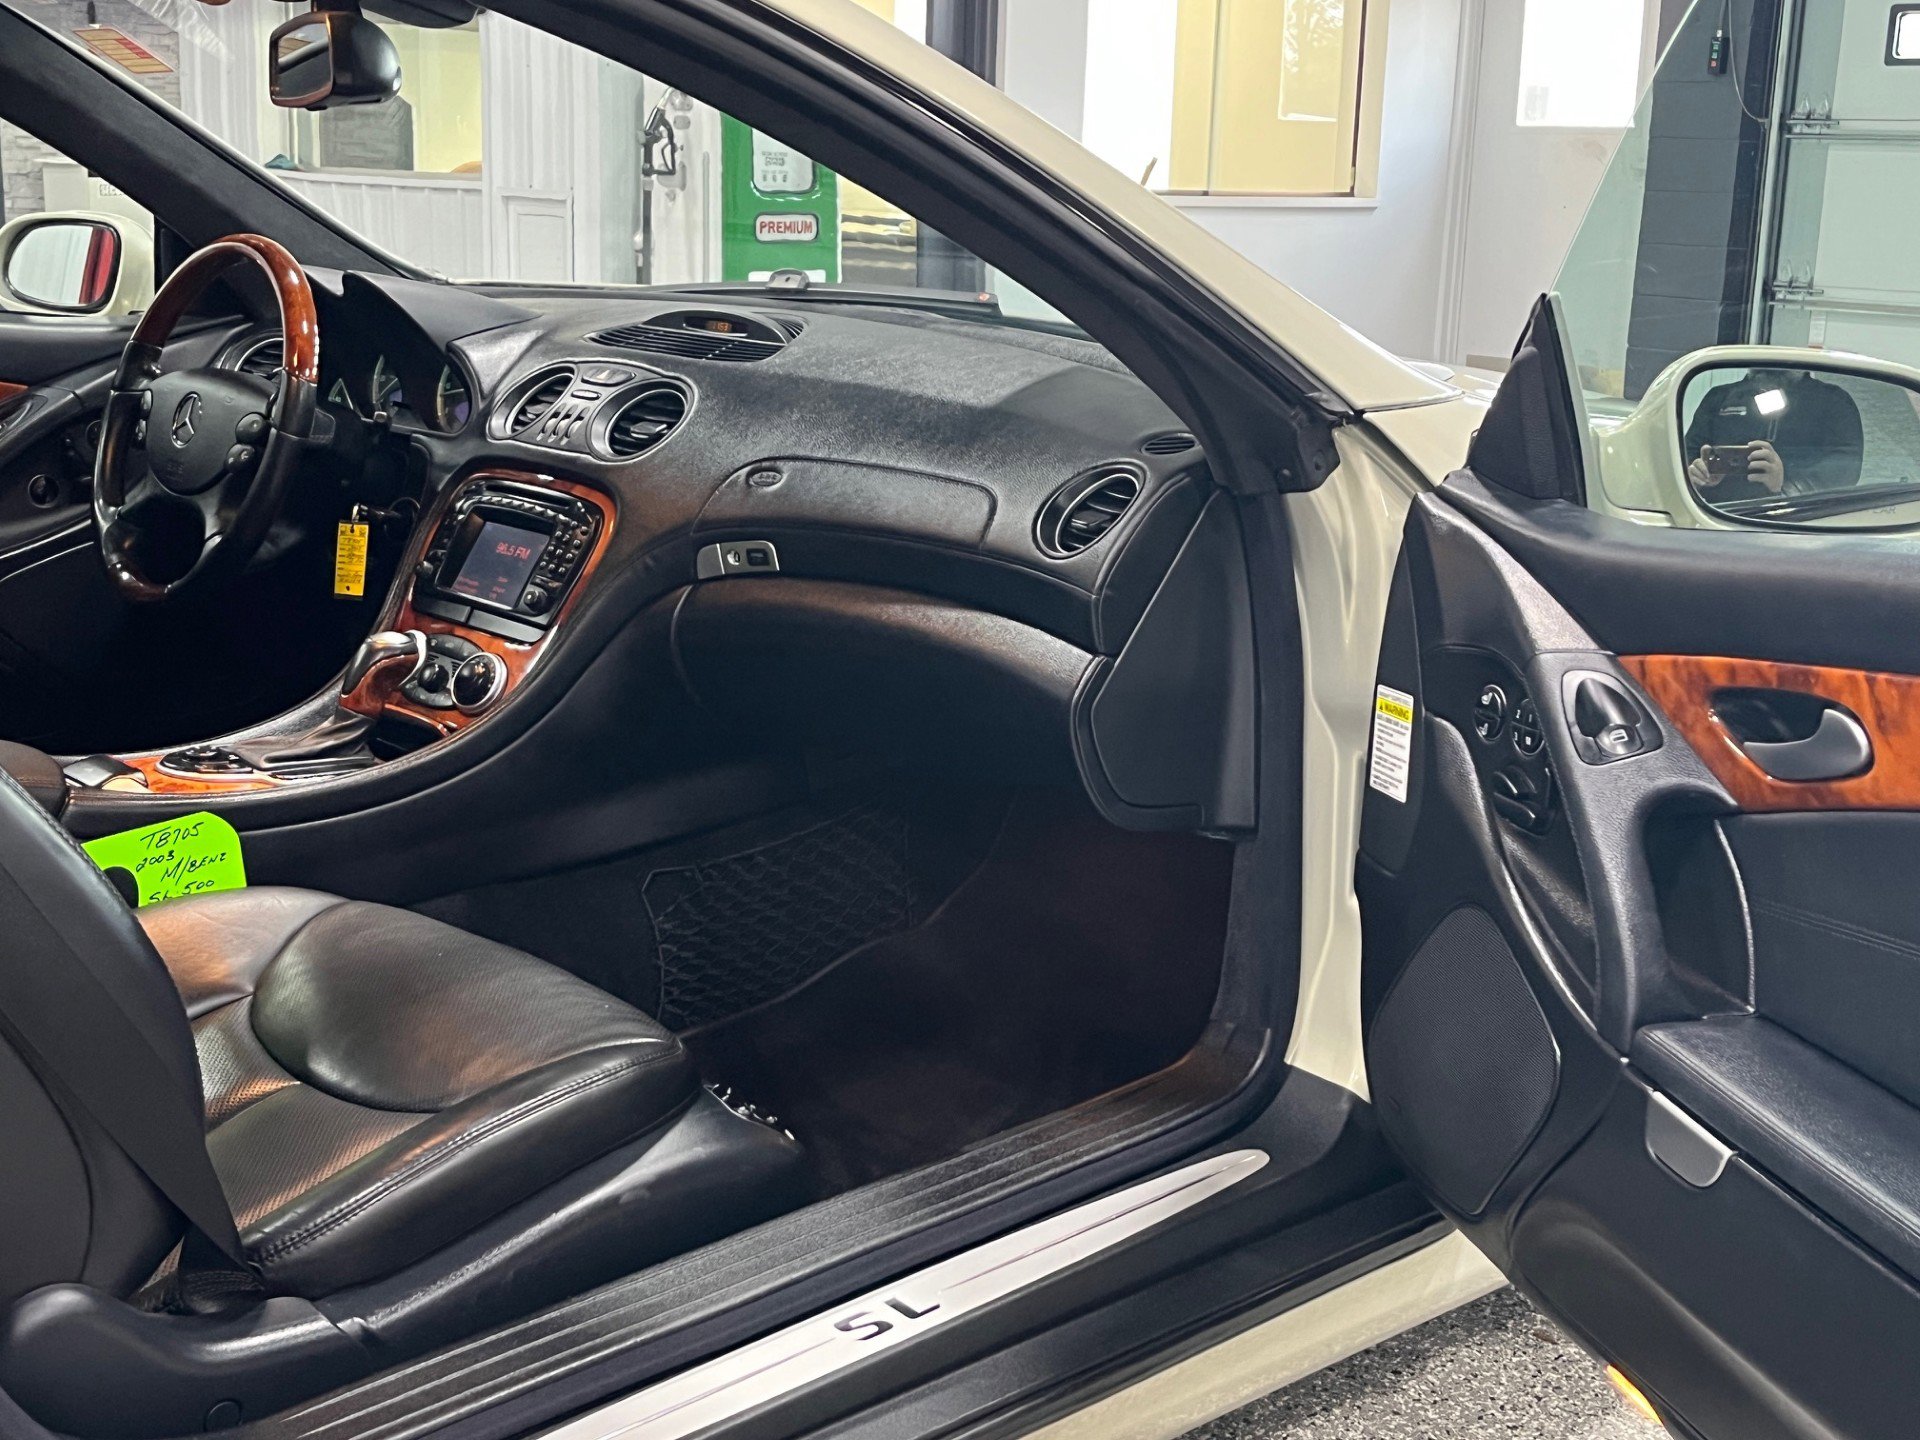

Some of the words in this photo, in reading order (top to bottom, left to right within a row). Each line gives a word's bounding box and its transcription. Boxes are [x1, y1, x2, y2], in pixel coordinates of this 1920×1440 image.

[759, 221, 813, 234] PREMIUM
[139, 821, 205, 850] T8705
[135, 849, 175, 873] 2003
[160, 852, 227, 886] M/BENZ
[181, 879, 215, 895] 500
[834, 1297, 941, 1342] SL
